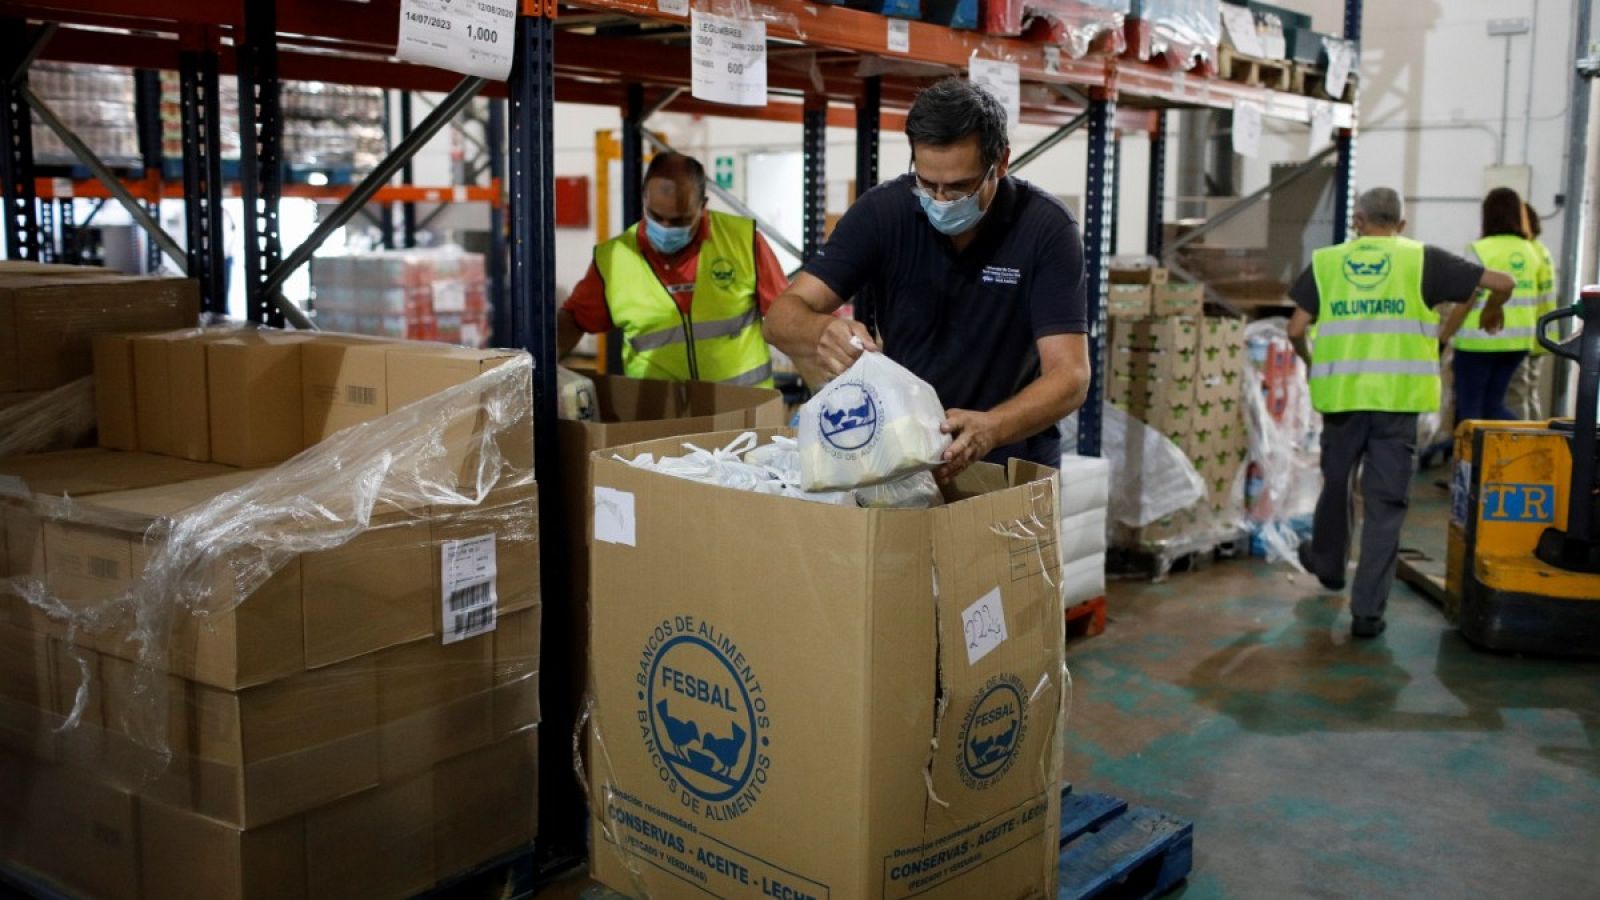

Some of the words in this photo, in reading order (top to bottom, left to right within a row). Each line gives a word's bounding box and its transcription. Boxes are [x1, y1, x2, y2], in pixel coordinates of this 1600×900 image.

[405, 11, 452, 30] 14/07/2023
[466, 24, 498, 43] 1,000
[727, 62, 744, 75] 600
[1330, 299, 1406, 316] VOLUNTARIO
[1487, 485, 1549, 520] TR
[636, 619, 673, 688] BANCOS
[675, 615, 695, 633] DE
[698, 620, 771, 730] ALIMENTOS
[661, 665, 738, 713] FESBAL
[974, 702, 1015, 729] FESBAL
[636, 709, 678, 794] BANCOS
[680, 791, 701, 815] DE
[704, 753, 771, 822] ALIMENTOS
[608, 803, 685, 854] CONSERVAS
[696, 847, 749, 886] ACEITE
[762, 876, 816, 900] LECH
[890, 840, 969, 881] CONSERVAS
[977, 817, 1015, 850] ACEITE
